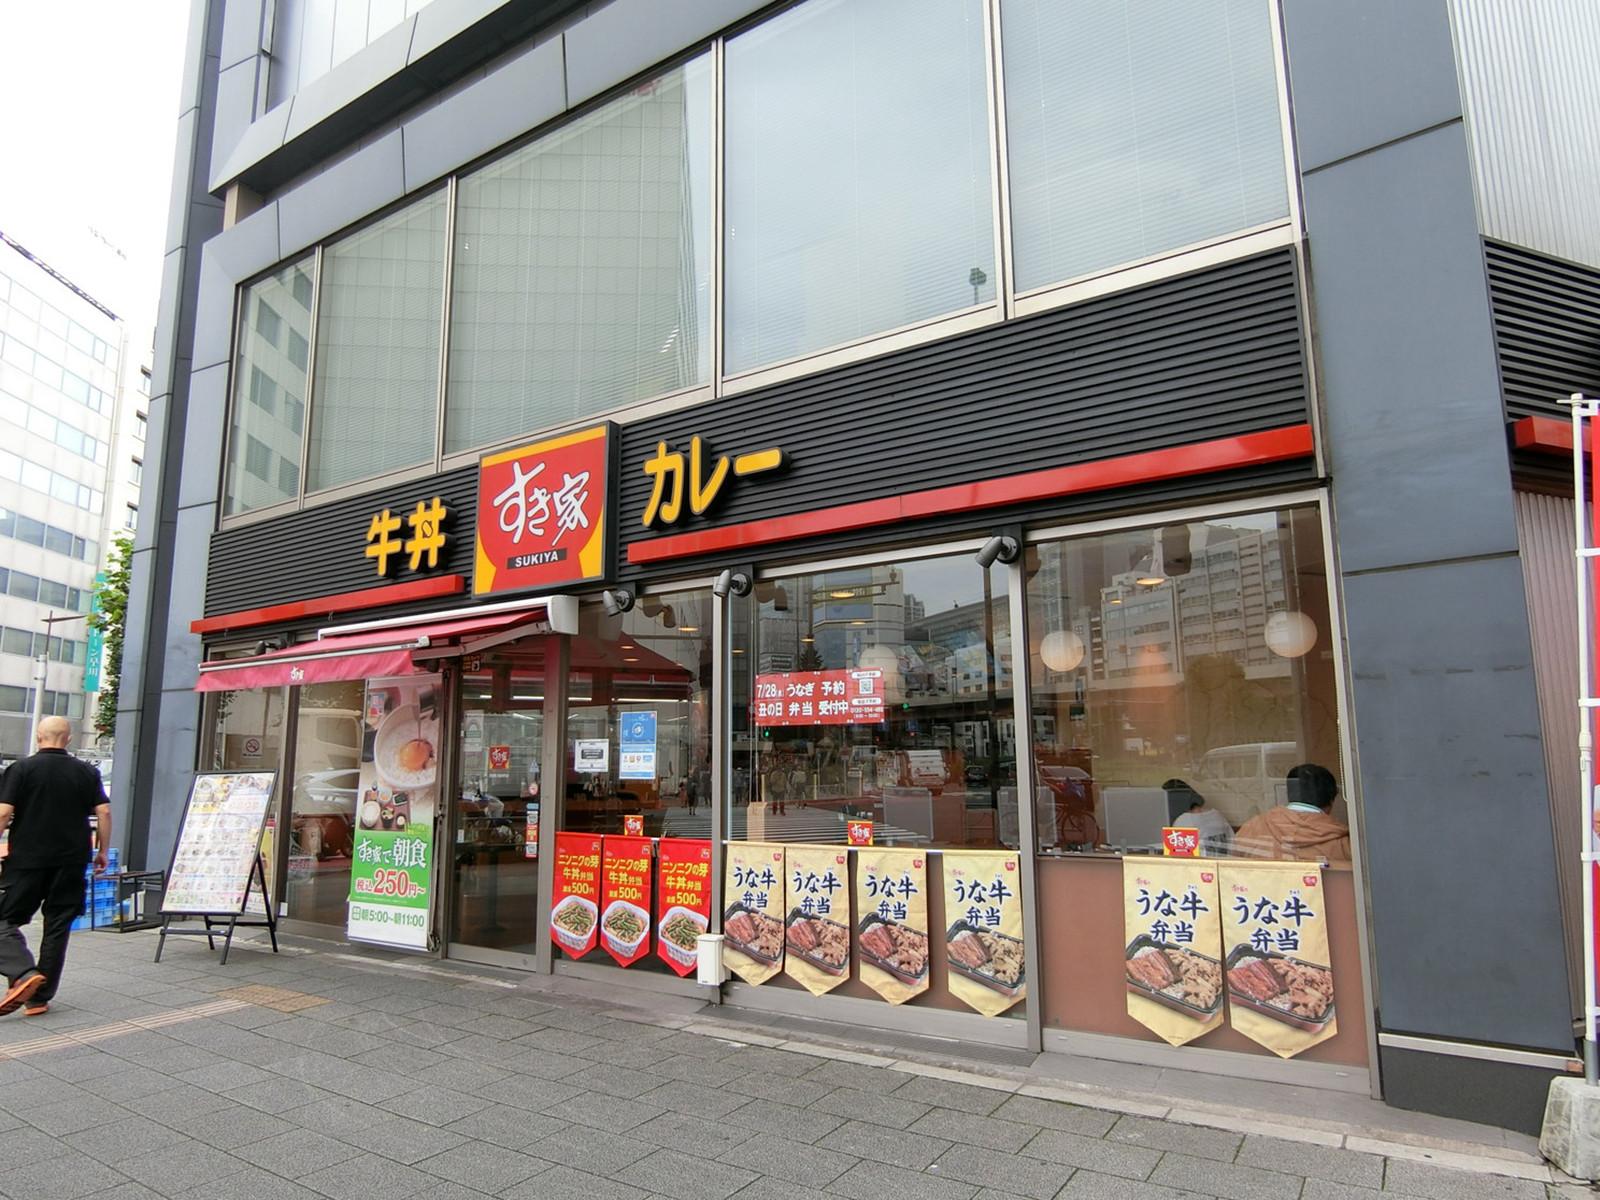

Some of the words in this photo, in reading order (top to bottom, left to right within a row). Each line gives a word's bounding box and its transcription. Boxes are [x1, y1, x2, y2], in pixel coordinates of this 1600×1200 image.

[642, 435, 782, 527] カレー
[493, 461, 591, 546] すき家
[365, 497, 447, 577] 牛丼
[515, 551, 559, 568] SUKIYA
[787, 682, 815, 697] うなぎ
[821, 681, 845, 696] 予約
[759, 702, 783, 716] 丑の日
[789, 702, 813, 716] 弁当
[819, 700, 848, 715] 受付中
[1167, 830, 1195, 849] すき家
[357, 837, 428, 868] すき家で朝食
[558, 854, 599, 867] ニンニクの芽
[563, 867, 594, 881] 牛丼弁当
[605, 858, 648, 873] ニンニクの芽
[662, 862, 709, 877] ニンニクの芽
[609, 871, 643, 886] 牛丼弁当
[666, 875, 701, 891] 牛丼弁当
[733, 867, 776, 890] うな牛
[793, 871, 842, 895] うな牛
[865, 874, 918, 900] うな牛
[742, 890, 767, 908] 弁当
[953, 879, 1012, 905] うな牛
[801, 896, 830, 914] 弁当
[877, 900, 906, 921] 弁当
[1136, 889, 1209, 920] うな牛
[1233, 896, 1314, 927] うな牛
[966, 906, 1000, 927] 弁当
[1151, 920, 1194, 943] 弁当
[1250, 927, 1299, 952] 弁当
